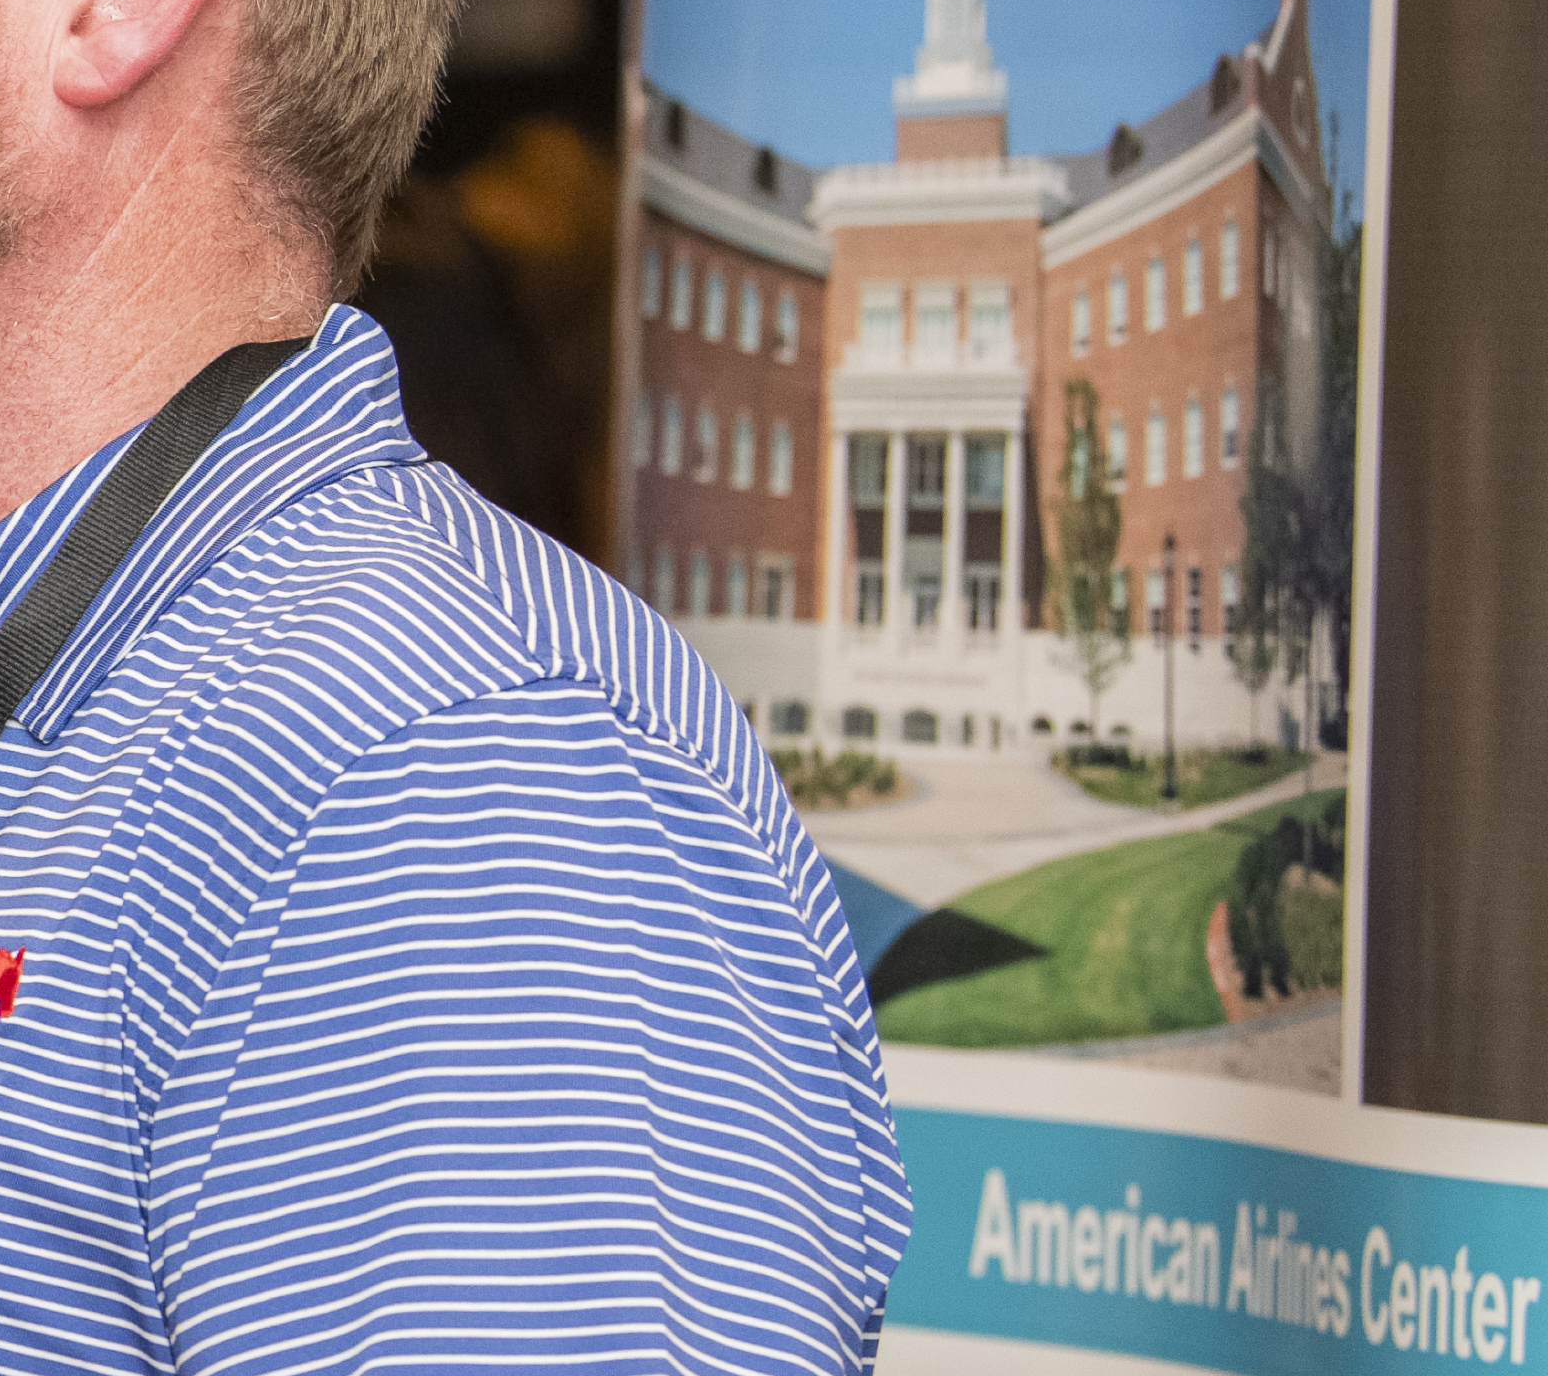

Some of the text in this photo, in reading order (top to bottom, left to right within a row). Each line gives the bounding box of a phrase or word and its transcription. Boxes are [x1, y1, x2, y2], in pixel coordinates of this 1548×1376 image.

[967, 1167, 1540, 1365] American Airlines Center
